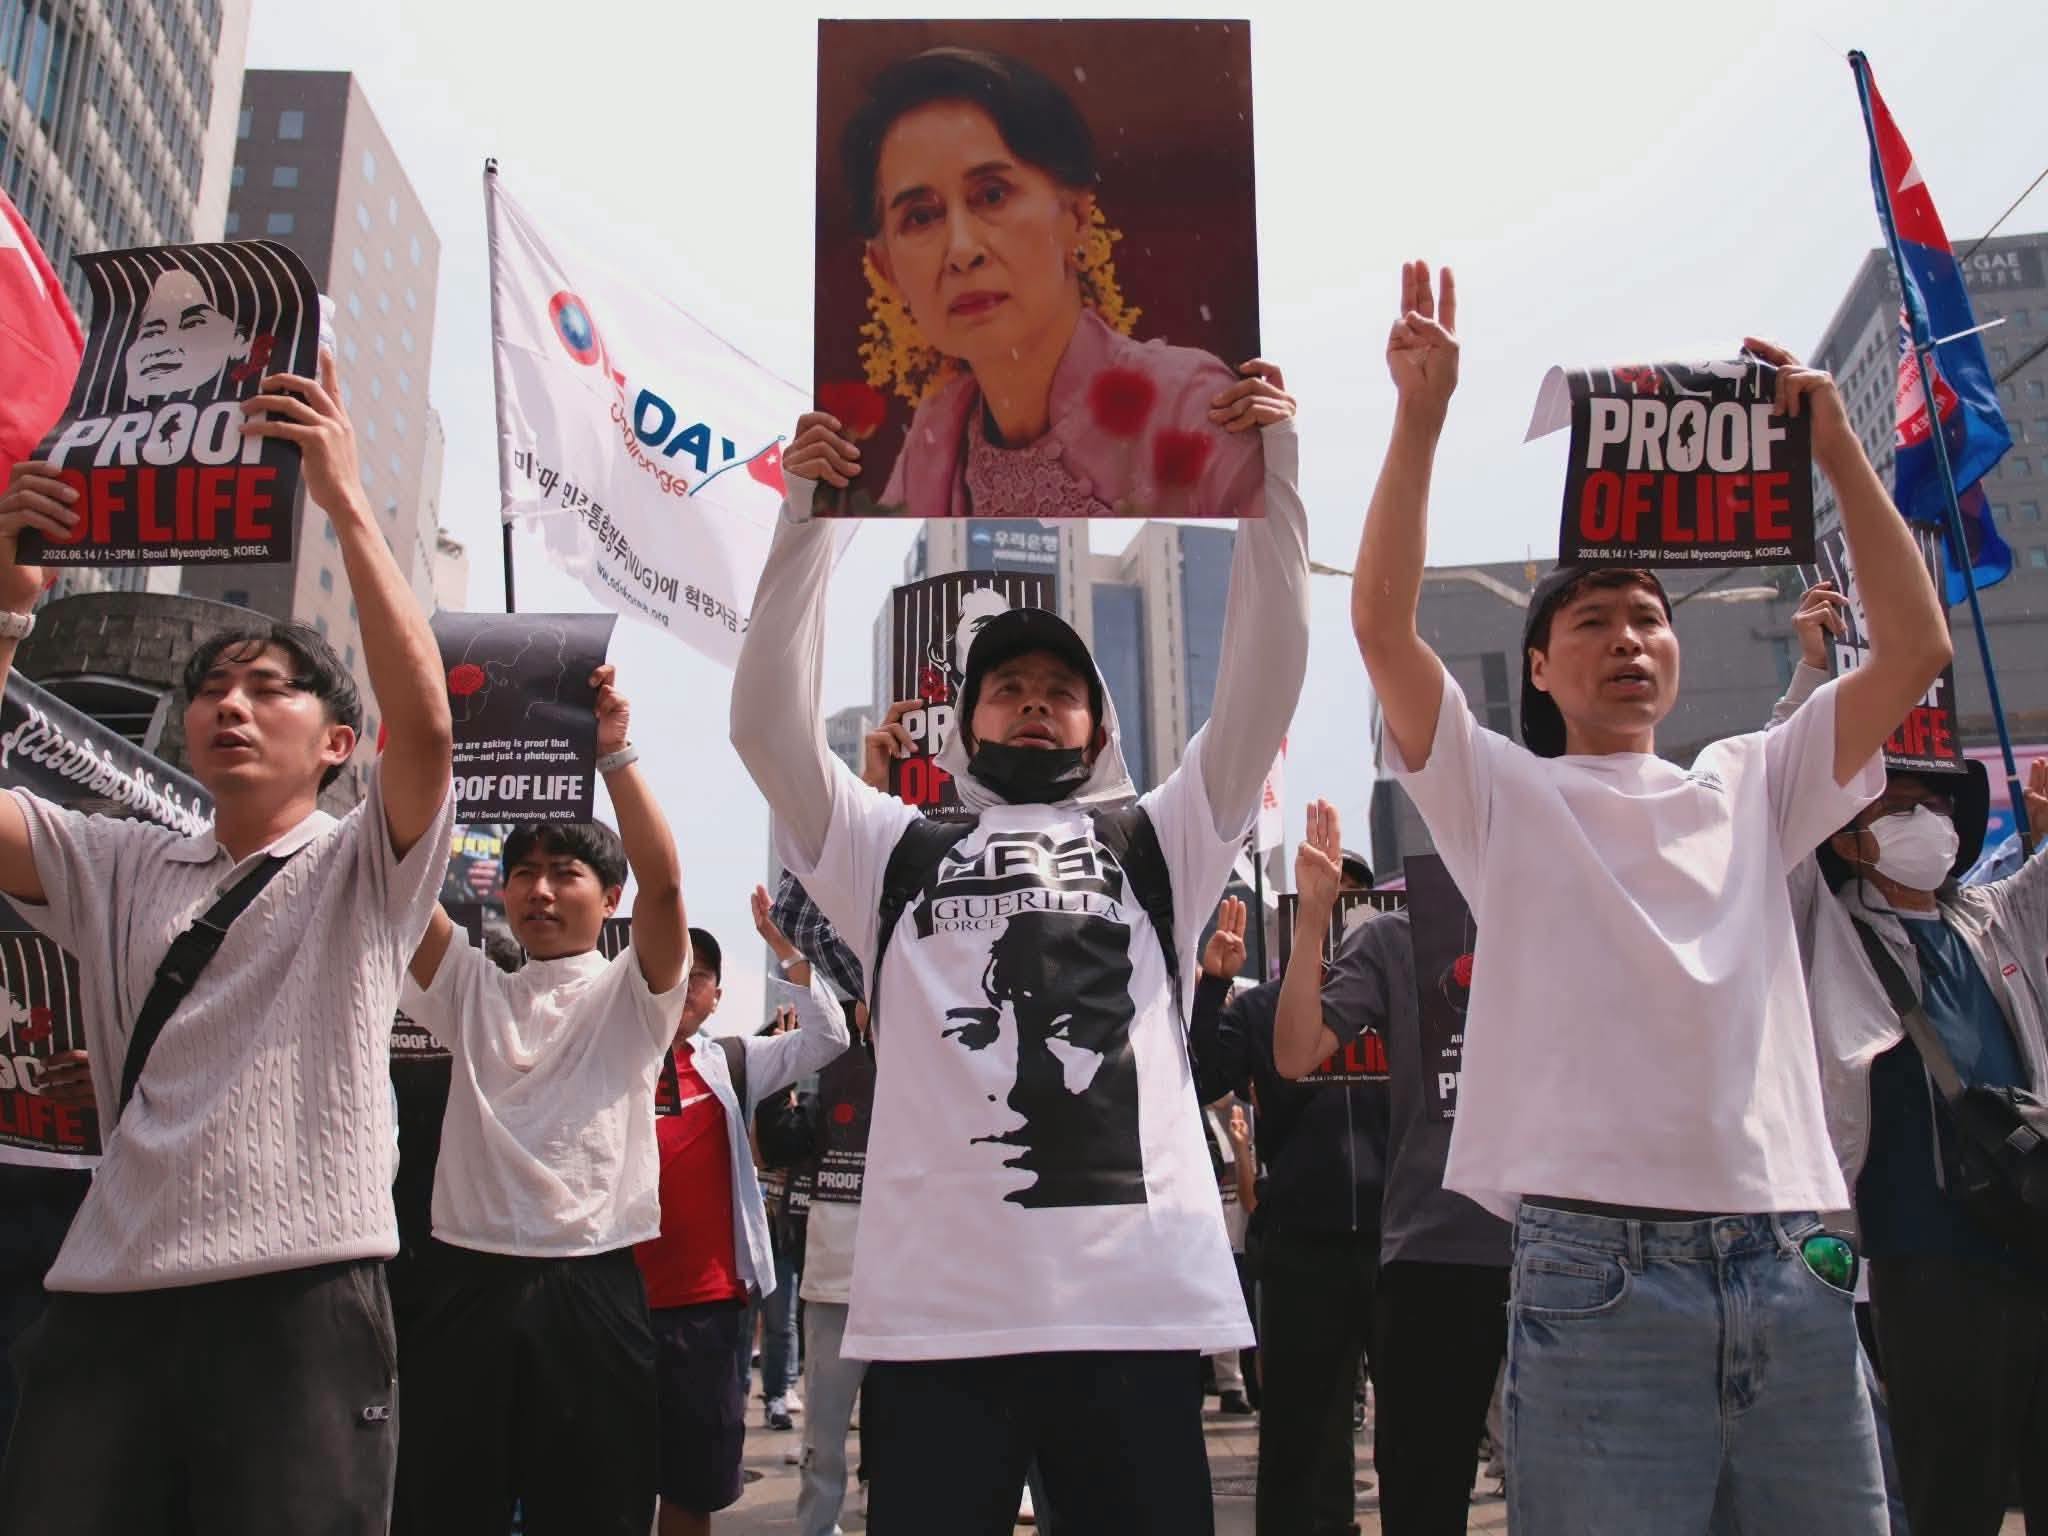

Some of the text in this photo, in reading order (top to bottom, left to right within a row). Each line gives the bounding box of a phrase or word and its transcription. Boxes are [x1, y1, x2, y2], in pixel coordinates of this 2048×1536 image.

[1586, 398, 1787, 472] PROOF
[137, 467, 278, 544] LIFE
[1579, 471, 1792, 542] OF LIFE
[143, 548, 168, 560] Seoul
[233, 545, 269, 557] KOREA
[1663, 549, 1689, 560] Seoul
[1755, 546, 1792, 558] KOREA
[465, 742, 480, 750] are
[482, 739, 512, 751] asking
[513, 738, 521, 748] is
[524, 738, 548, 751] proof
[551, 738, 569, 749] that
[496, 751, 514, 763] just
[515, 753, 523, 761] a
[524, 751, 580, 764] photograph.
[453, 774, 584, 801] OOF OF LIFE
[481, 809, 501, 819] Seoul
[549, 810, 576, 819] KOREA
[935, 889, 1122, 922] GUERILLA
[935, 918, 1001, 936] FORCE
[1441, 1047, 1458, 1057] she
[817, 1170, 863, 1190] PROOF
